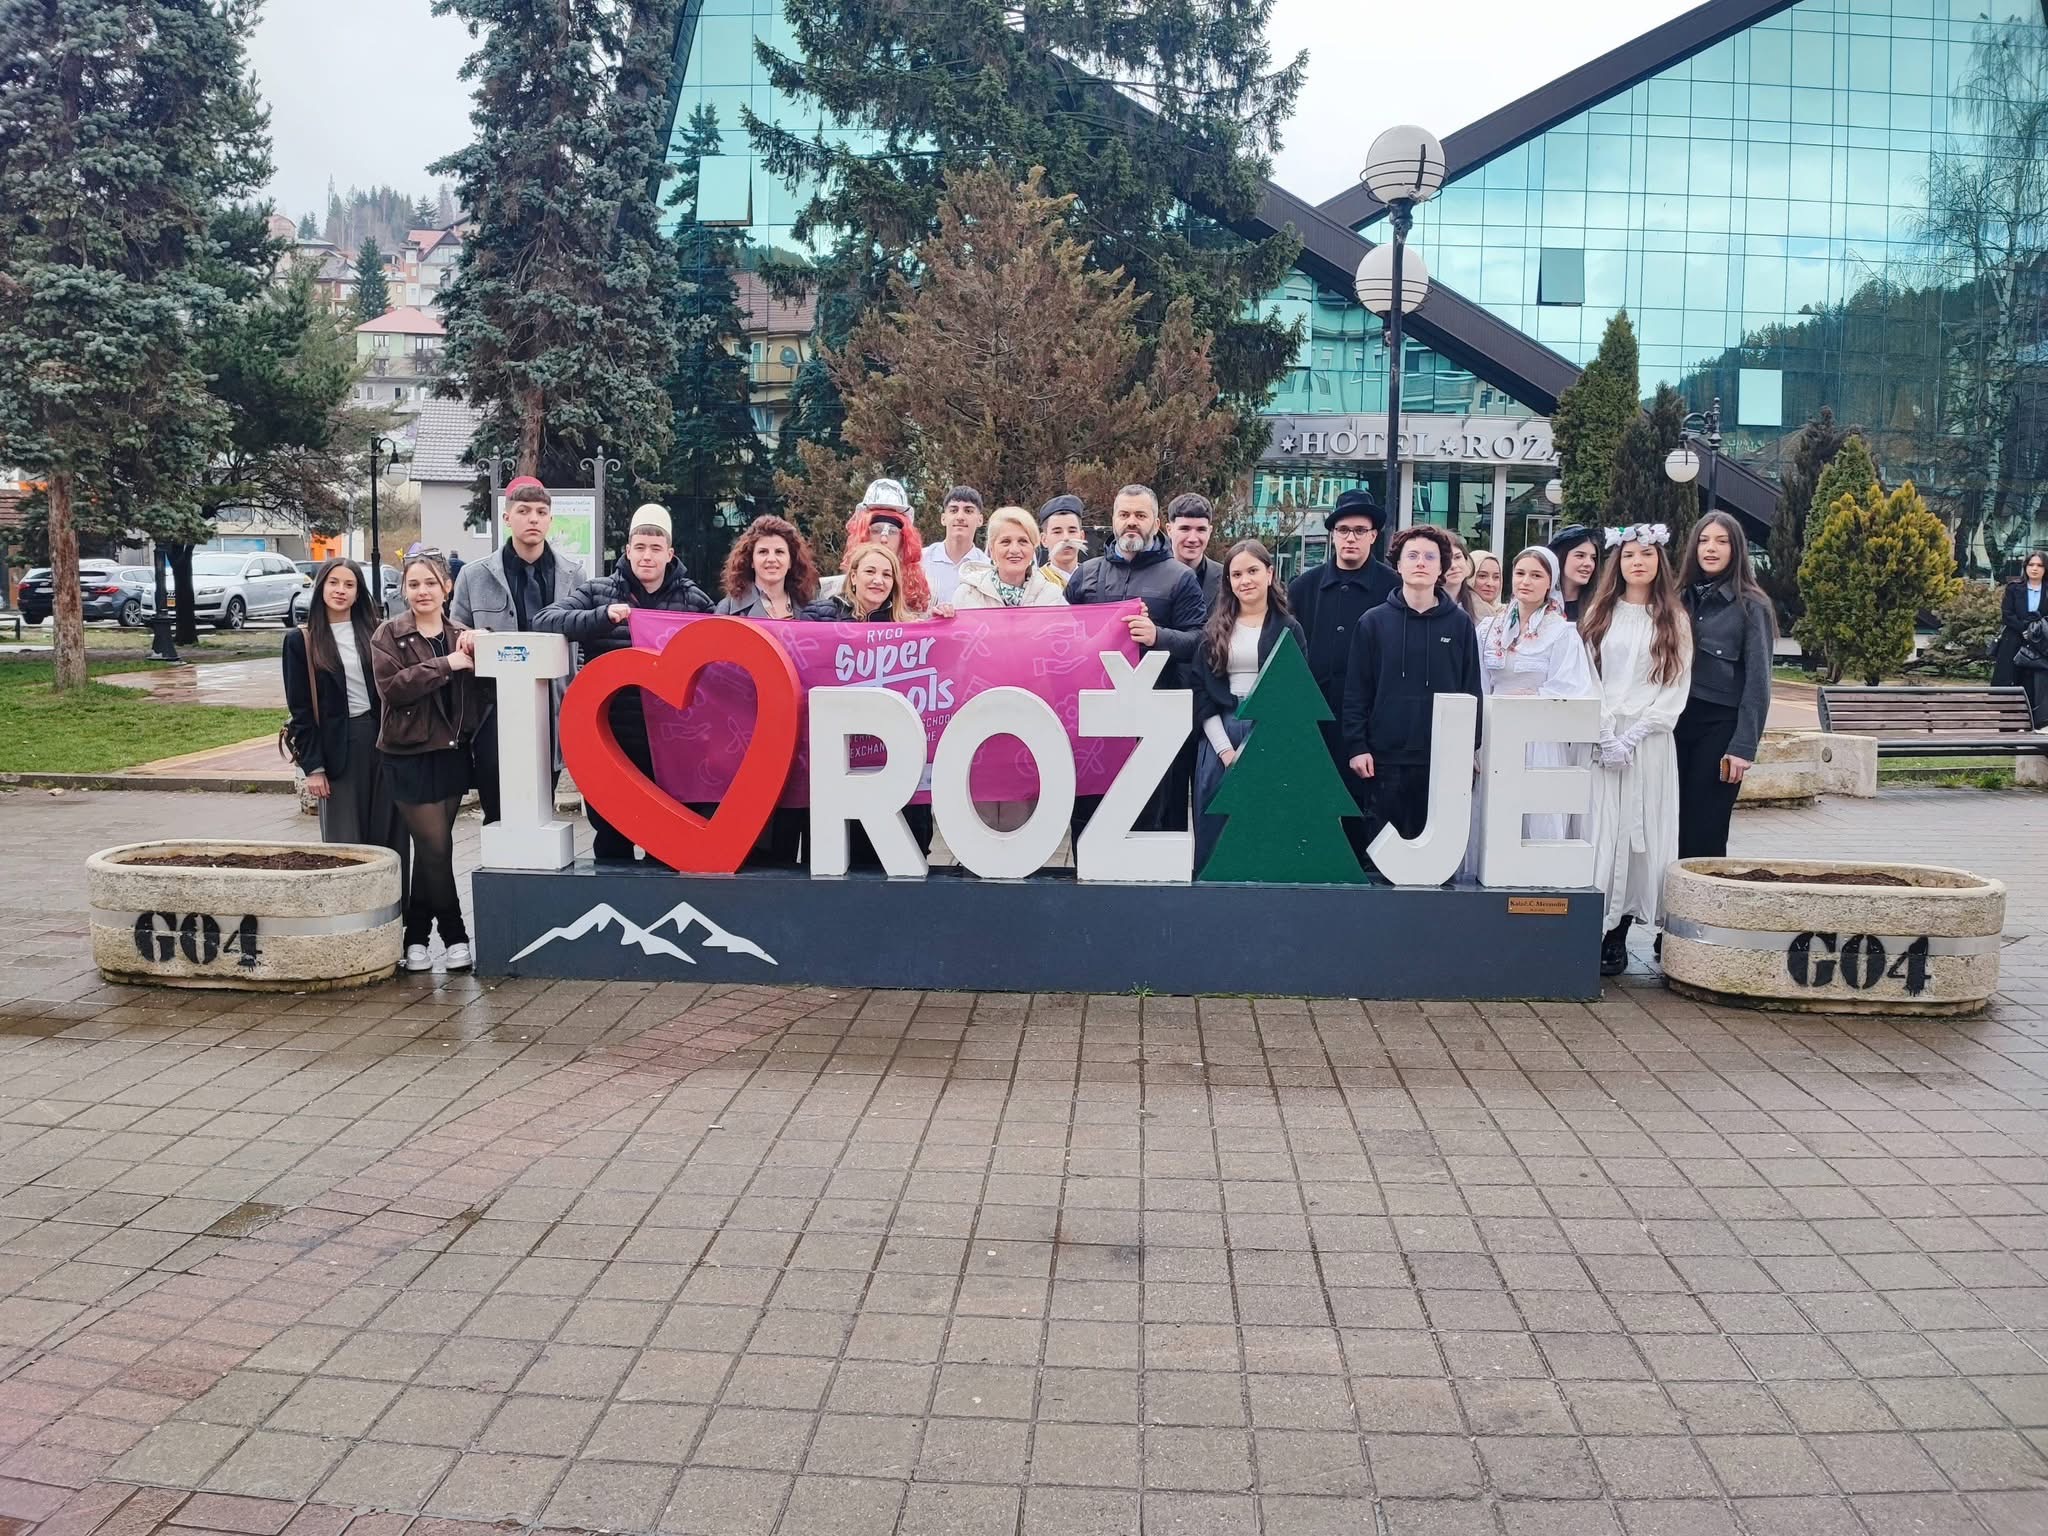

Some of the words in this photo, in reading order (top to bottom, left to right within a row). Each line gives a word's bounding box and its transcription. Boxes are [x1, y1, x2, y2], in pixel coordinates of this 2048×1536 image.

[867, 627, 904, 644] RYCO
[835, 636, 937, 684] Super
[474, 632, 574, 870] I
[850, 742, 885, 759] EXCHAN
